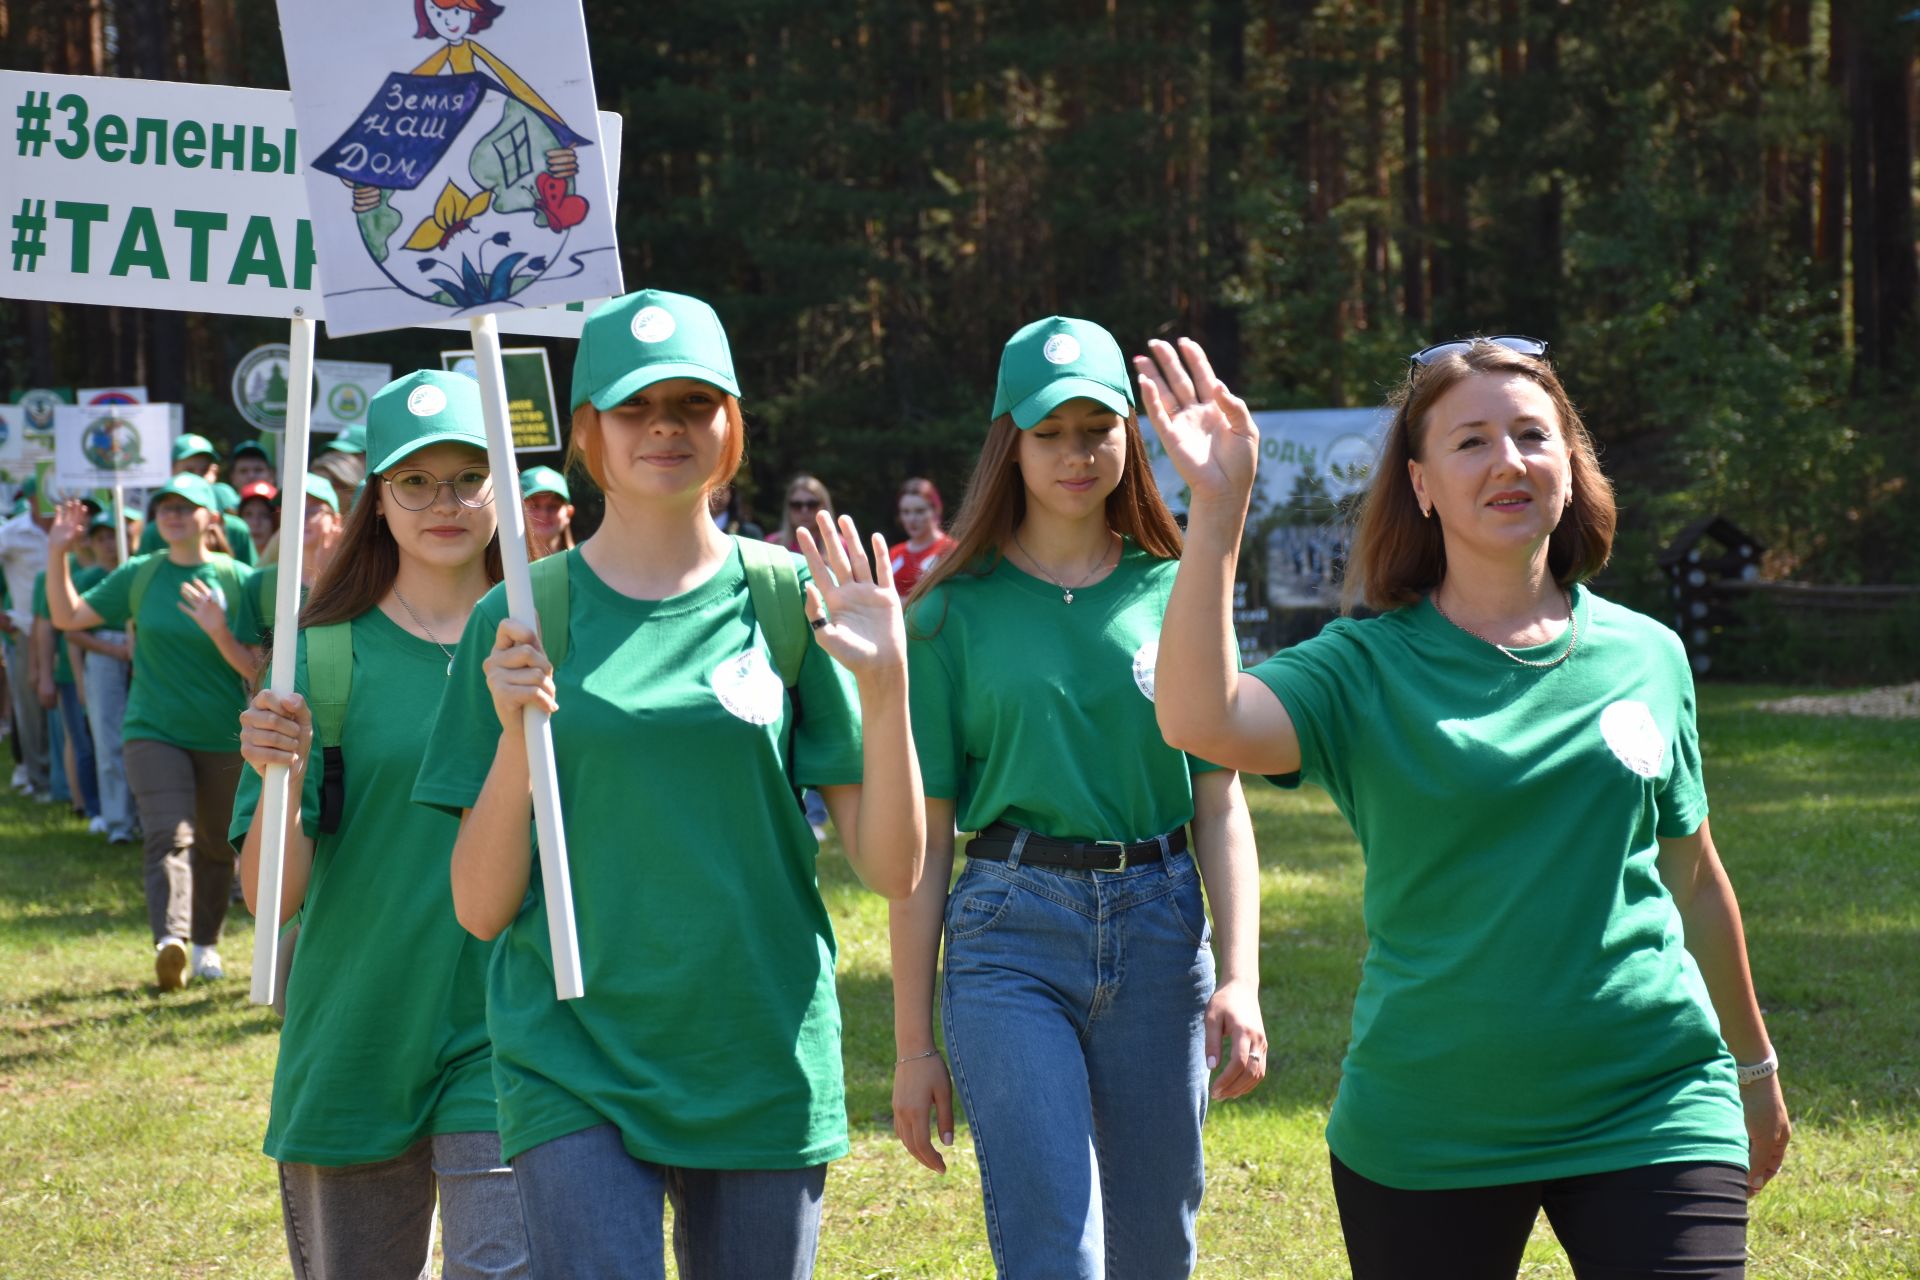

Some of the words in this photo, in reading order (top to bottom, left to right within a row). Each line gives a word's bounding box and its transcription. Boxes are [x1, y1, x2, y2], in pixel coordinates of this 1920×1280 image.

[384, 83, 465, 112] Земля
[16, 90, 297, 175] #Зелены
[335, 142, 418, 180] Дом
[1262, 437, 1317, 465] ОДЫ
